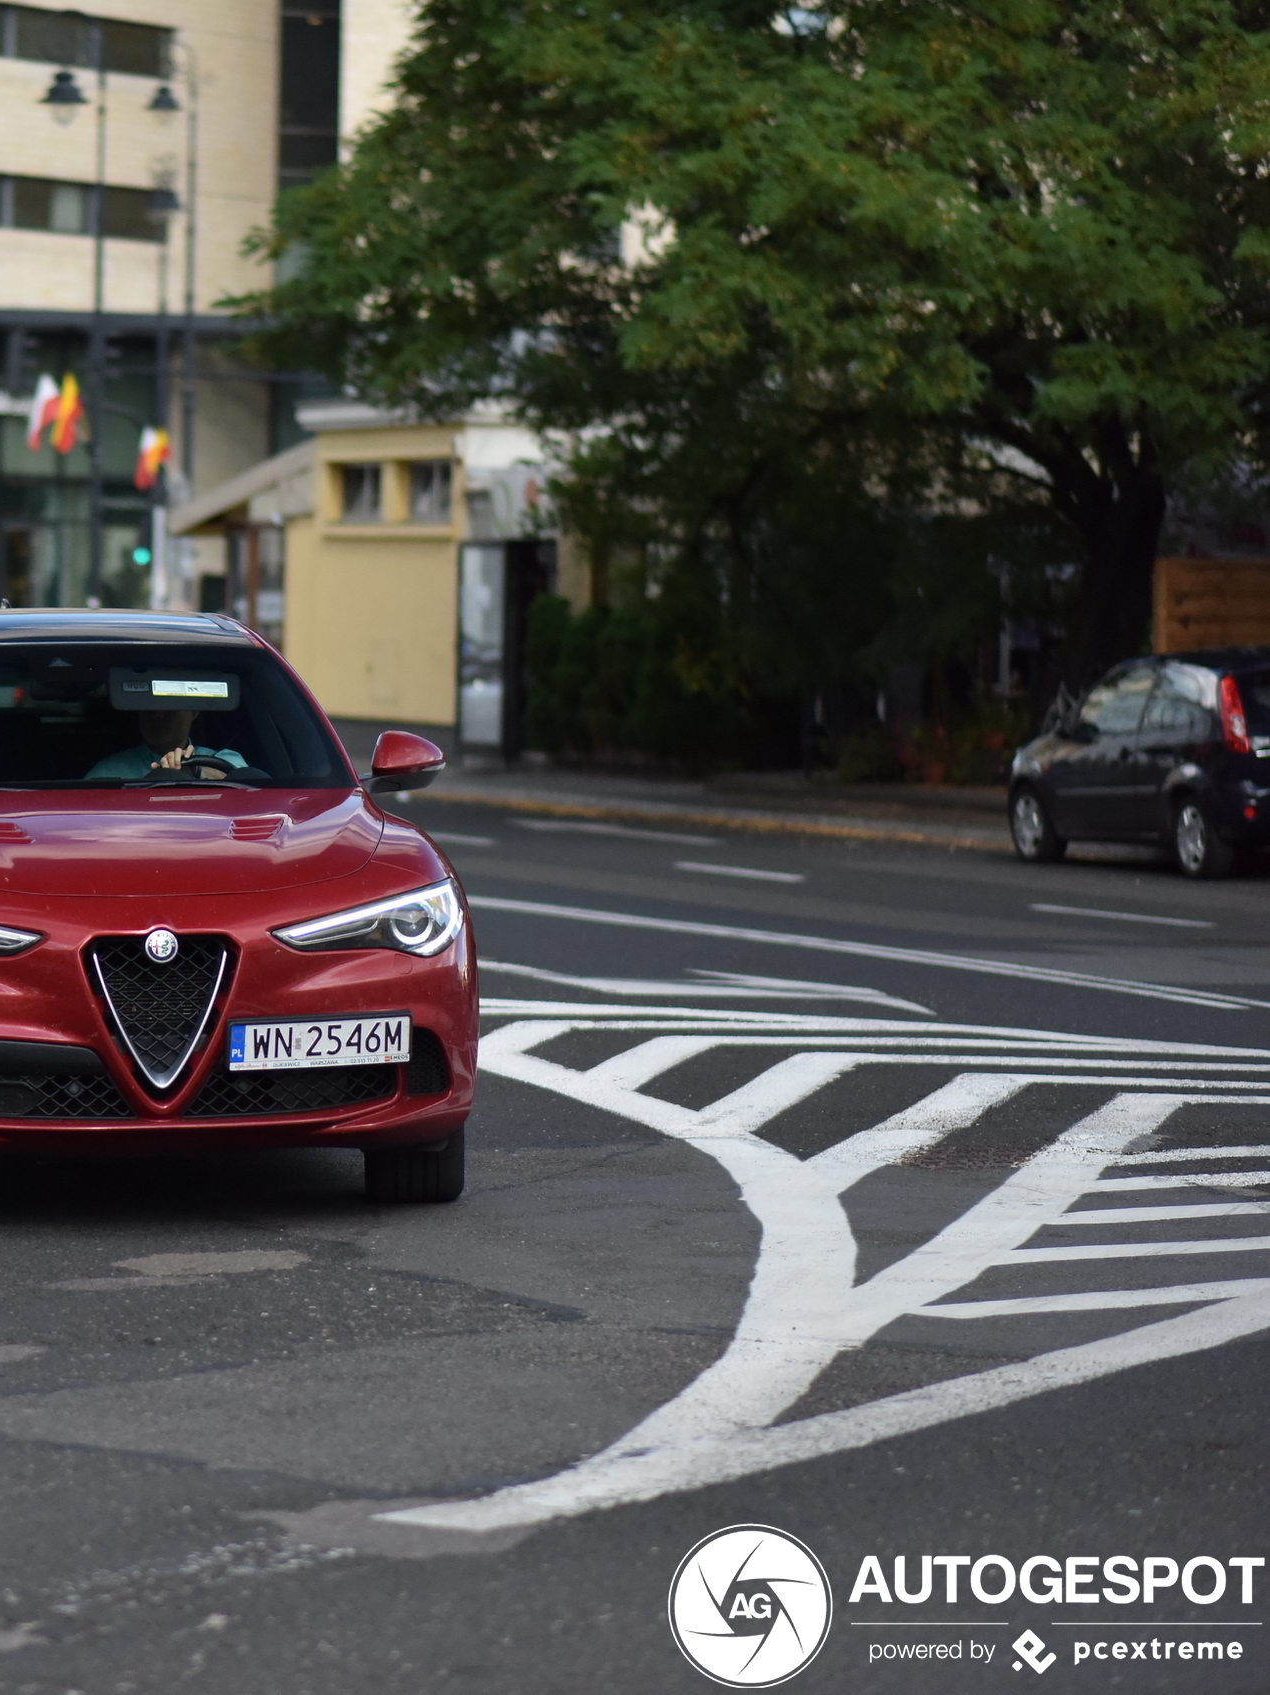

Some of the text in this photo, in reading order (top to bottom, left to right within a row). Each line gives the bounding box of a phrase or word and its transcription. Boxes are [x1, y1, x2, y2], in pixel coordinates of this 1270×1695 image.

[253, 1020, 402, 1059] WN 2546M
[231, 1048, 243, 1058] PL
